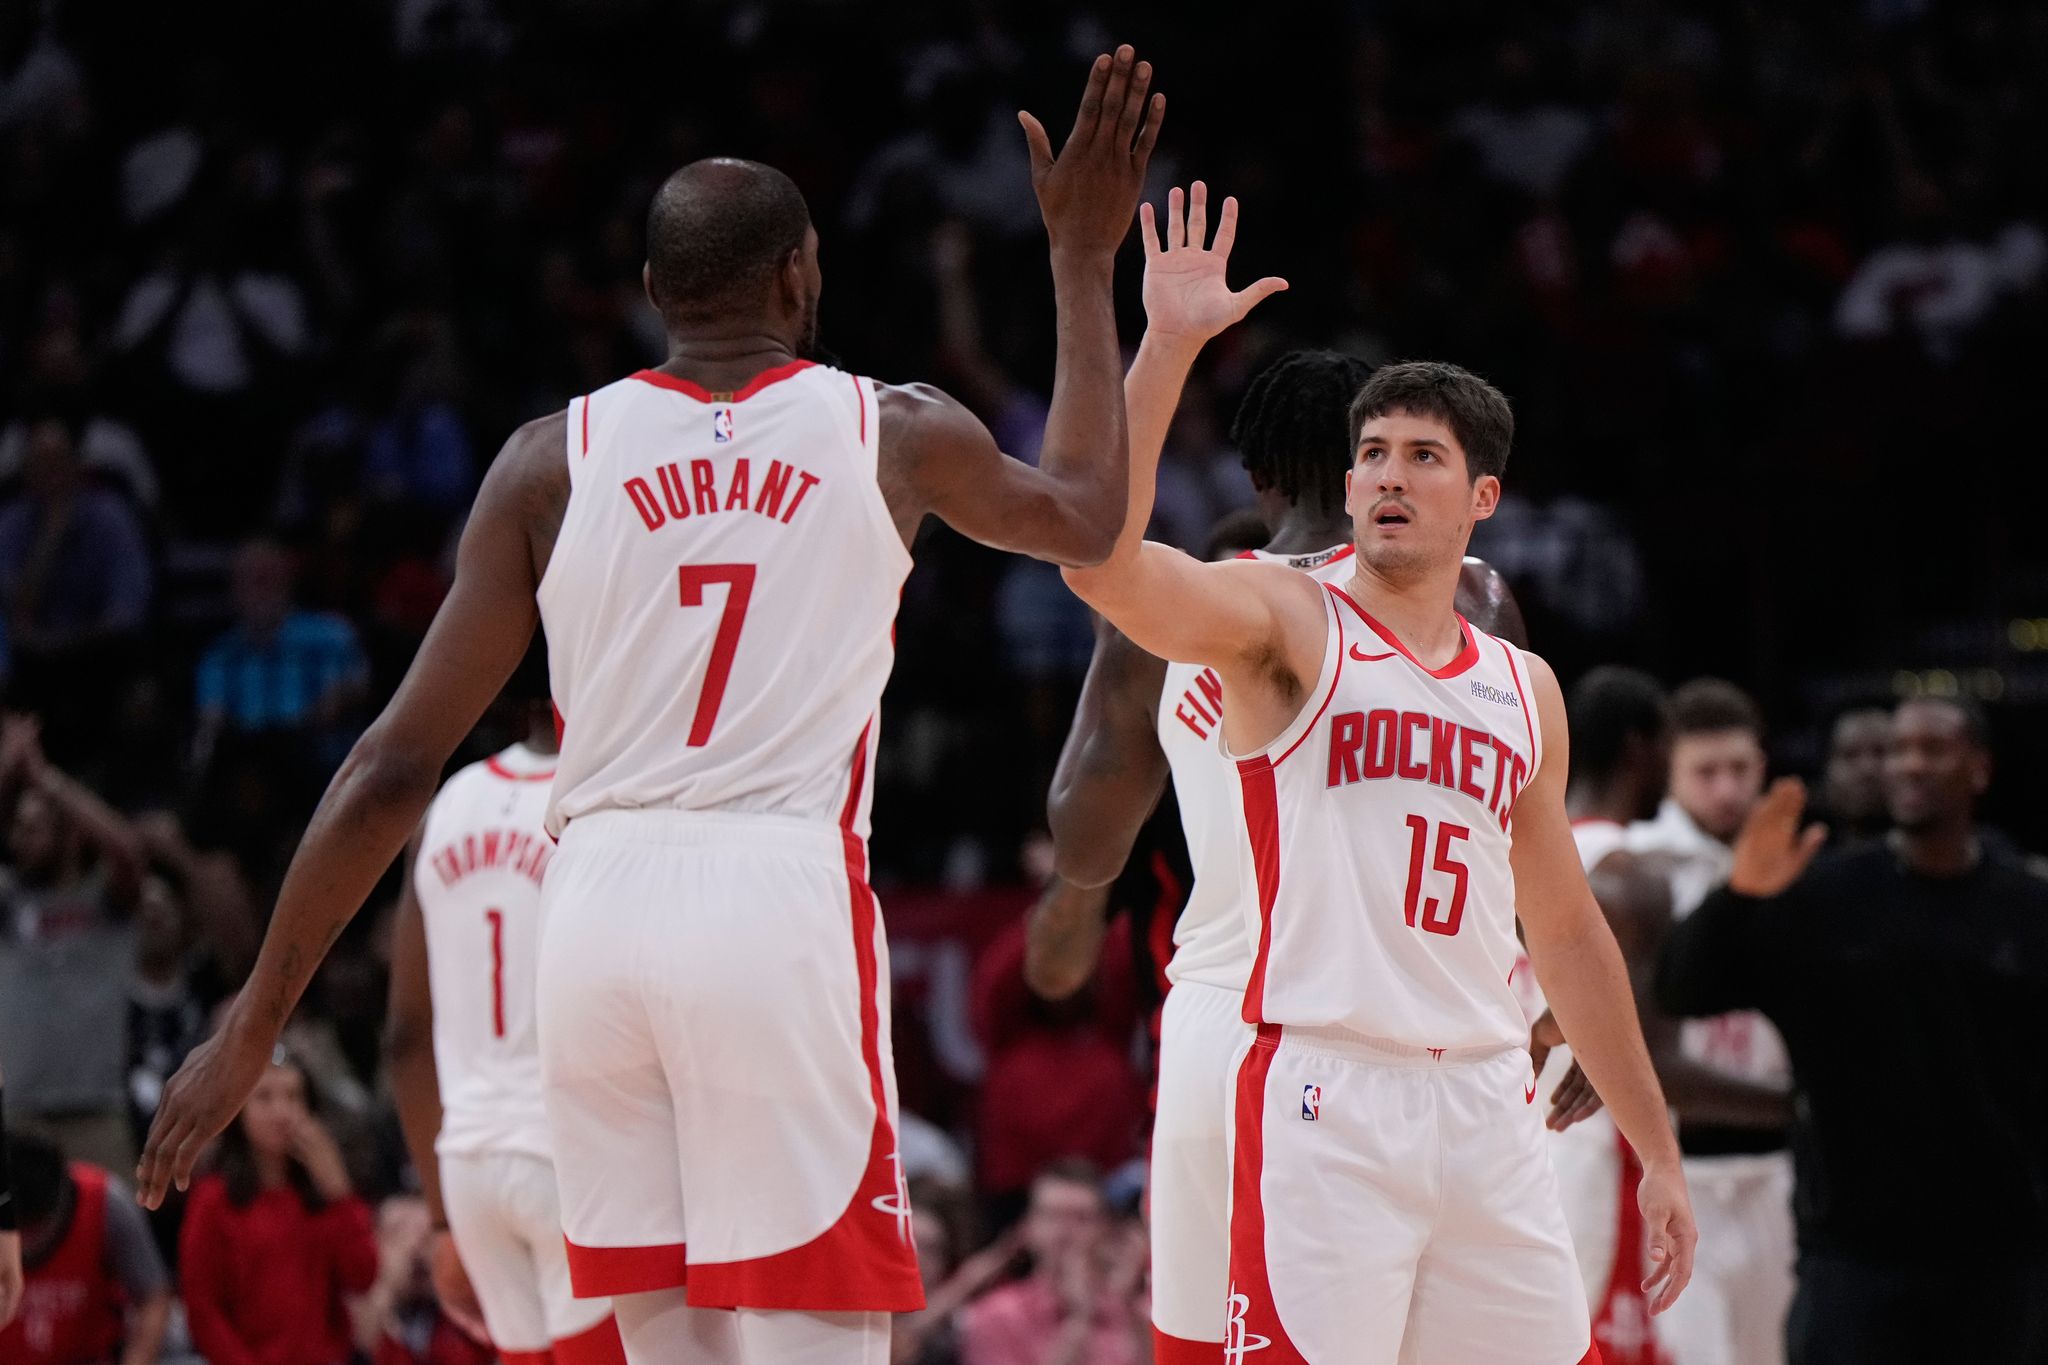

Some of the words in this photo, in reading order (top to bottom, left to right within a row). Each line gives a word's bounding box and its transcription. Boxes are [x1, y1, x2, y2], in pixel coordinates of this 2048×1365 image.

[623, 457, 821, 532] DURANT
[679, 564, 757, 747] 7
[1471, 680, 1517, 702] MEMORIAL
[1471, 689, 1518, 707] HERMANN
[1326, 709, 1527, 834] ROCKETS
[1404, 814, 1469, 937] 15
[486, 908, 505, 1039] 1
